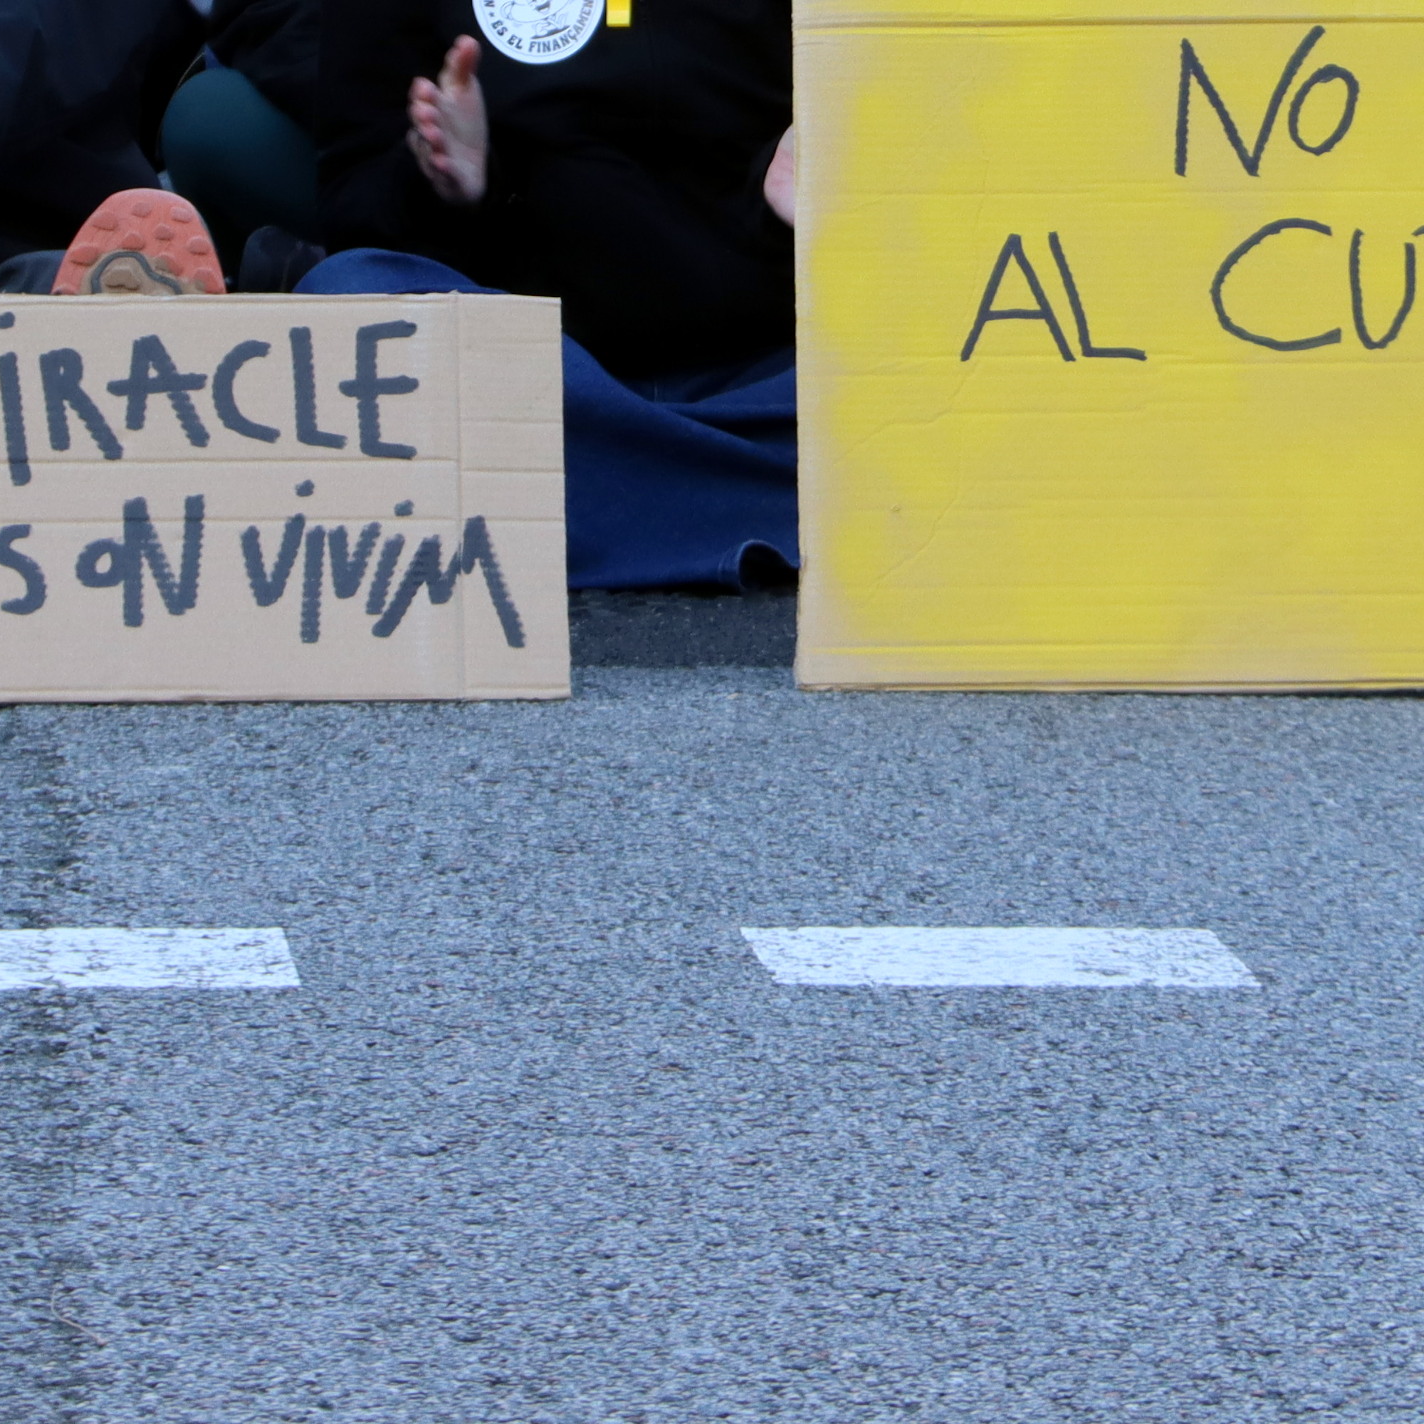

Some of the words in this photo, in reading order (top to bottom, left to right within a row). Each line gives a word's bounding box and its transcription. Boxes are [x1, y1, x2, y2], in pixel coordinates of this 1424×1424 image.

[507, 34, 523, 50] EL
[1175, 25, 1360, 177] NO
[960, 231, 1147, 362] AL
